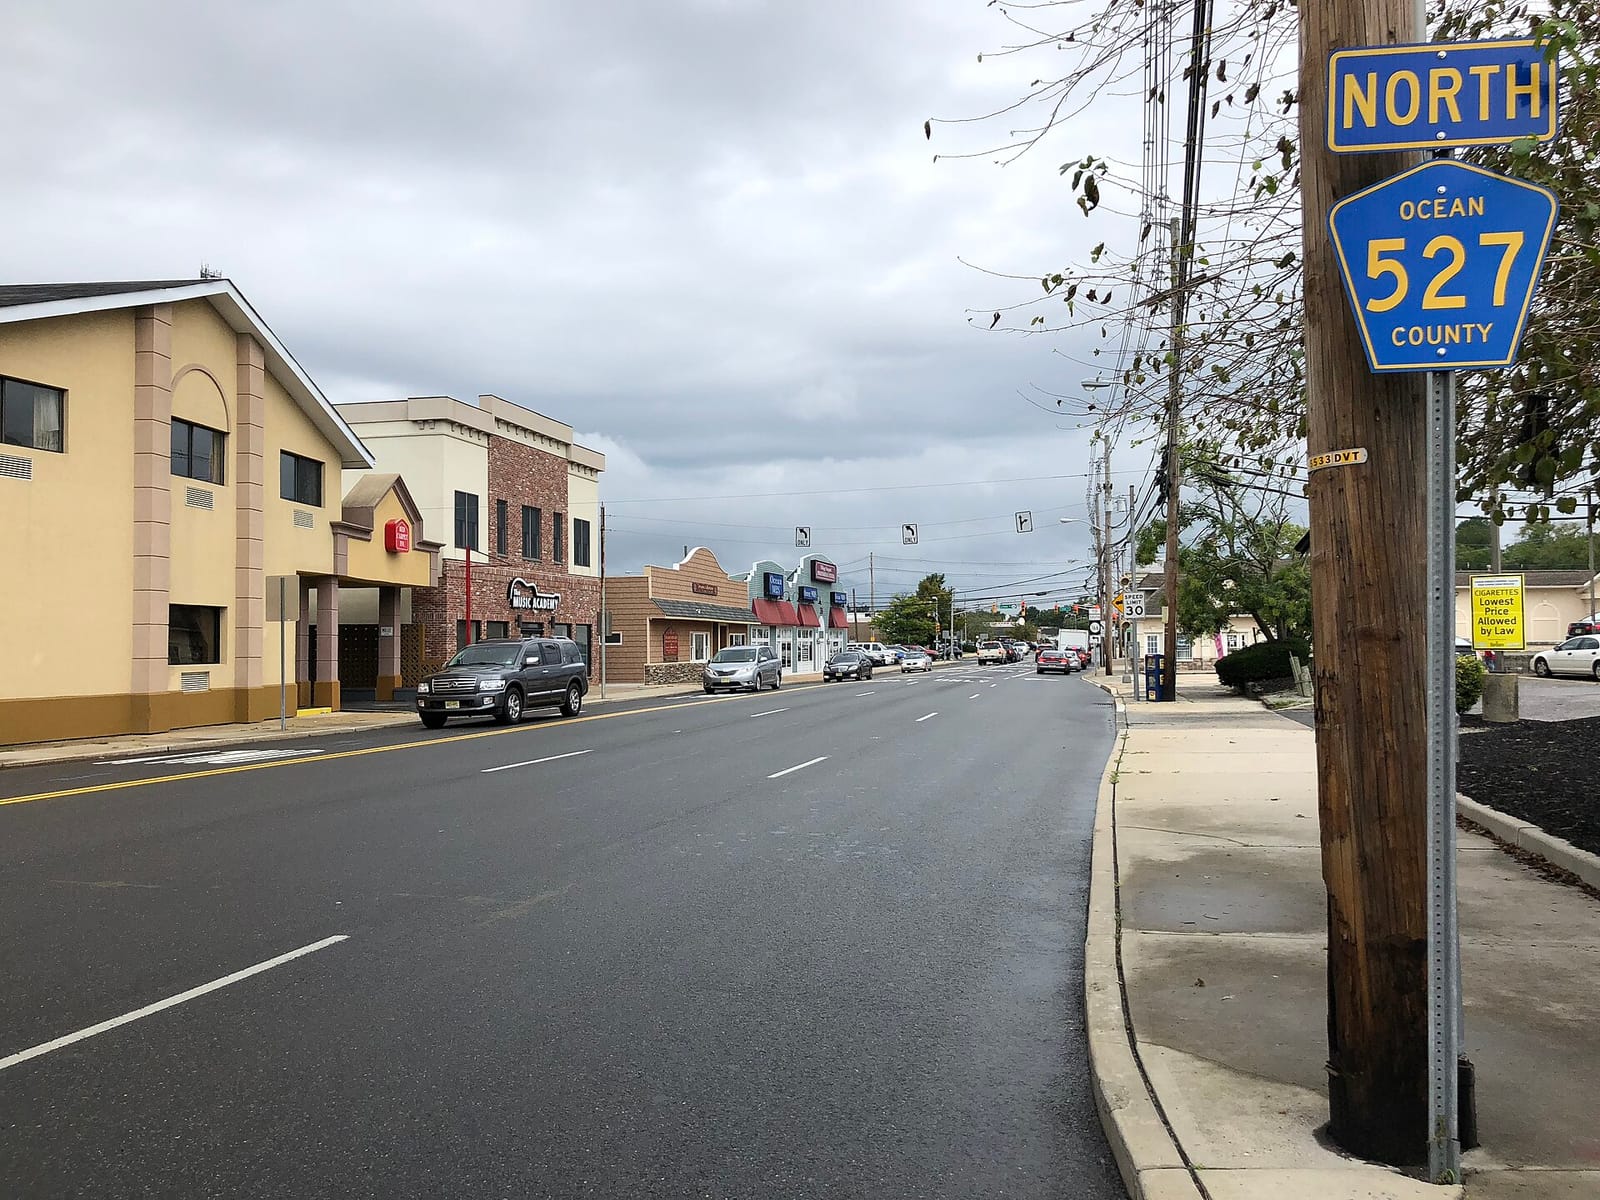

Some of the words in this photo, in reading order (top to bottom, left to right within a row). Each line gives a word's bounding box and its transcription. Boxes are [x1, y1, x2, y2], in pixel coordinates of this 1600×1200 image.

[1343, 62, 1541, 129] NORTH
[1399, 196, 1485, 221] OCEAN
[1366, 231, 1524, 313] 527
[1391, 322, 1494, 346] COUNTY
[513, 597, 532, 608] MUSIC
[533, 598, 559, 609] ACADEMY
[1126, 606, 1143, 615] 30
[1485, 607, 1509, 615] Price
[1478, 617, 1517, 625] Allowed
[1480, 627, 1492, 637] by
[1494, 627, 1515, 635] Law
